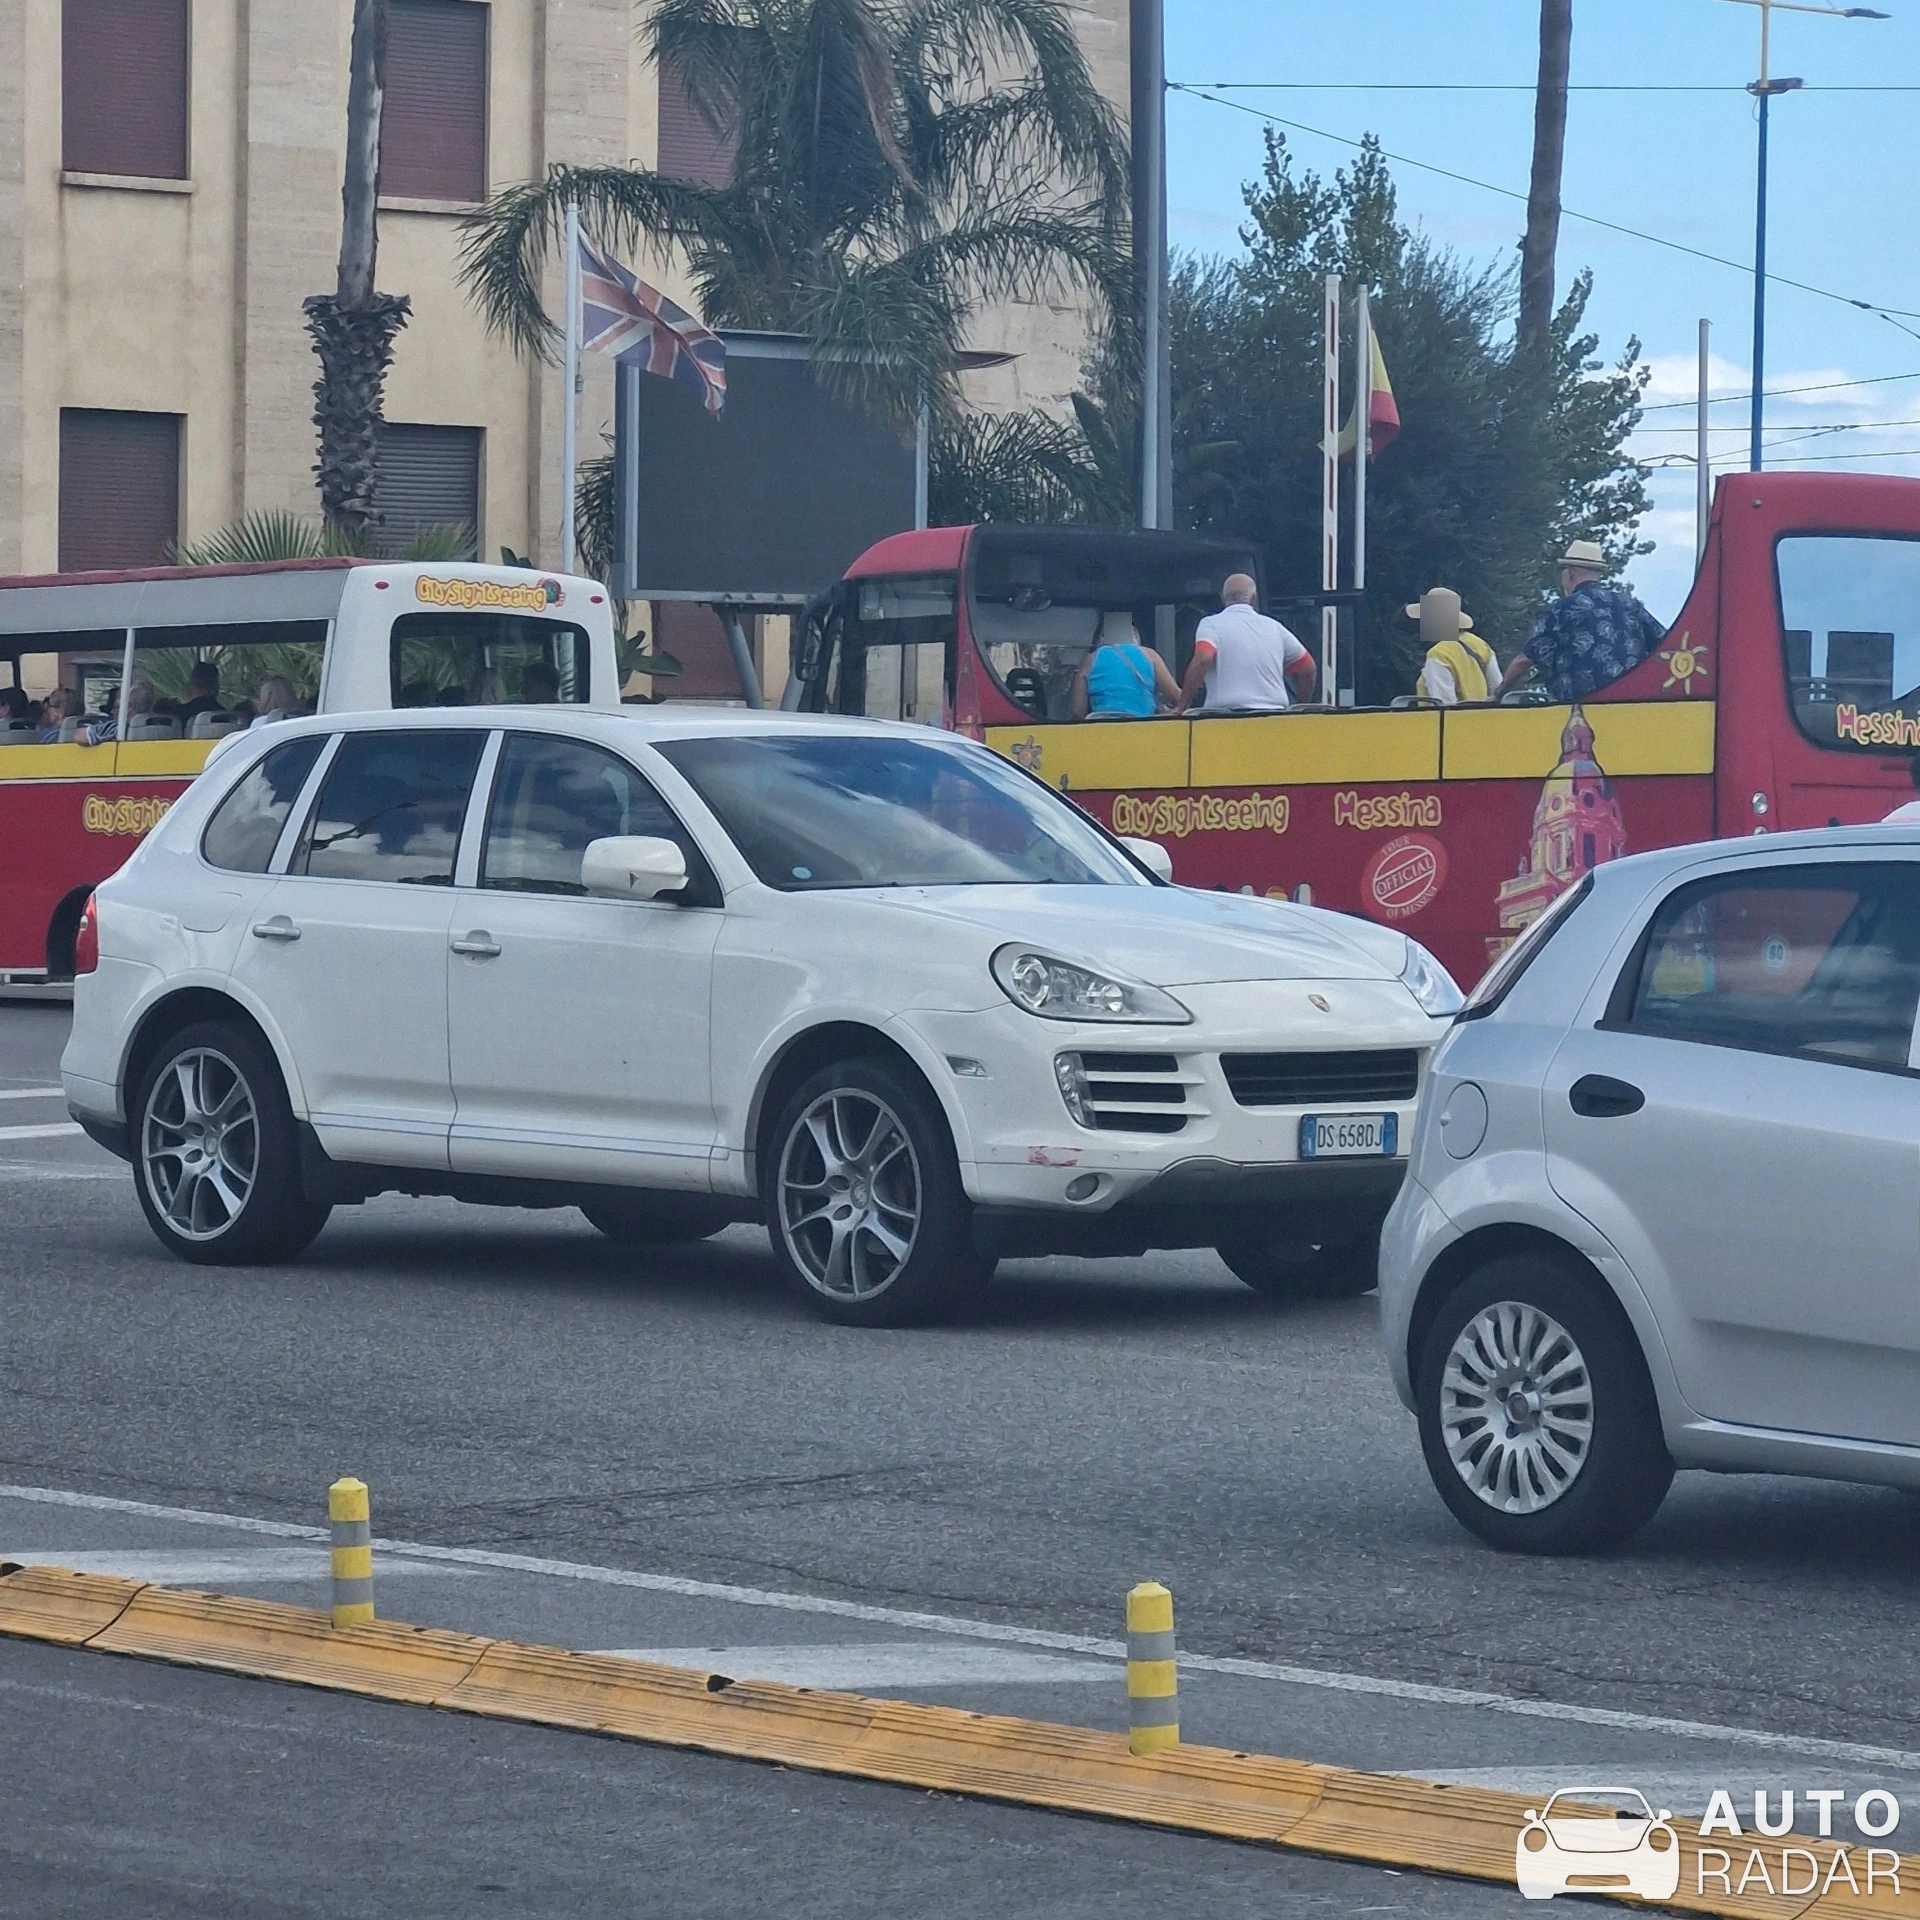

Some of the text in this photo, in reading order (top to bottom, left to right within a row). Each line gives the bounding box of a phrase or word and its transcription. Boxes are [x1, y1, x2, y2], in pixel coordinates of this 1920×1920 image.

[1334, 792, 1442, 831] Messina
[1376, 856, 1433, 895] OFFICIAL
[1318, 1124, 1334, 1148] DS
[1339, 1124, 1383, 1147] 658DJ
